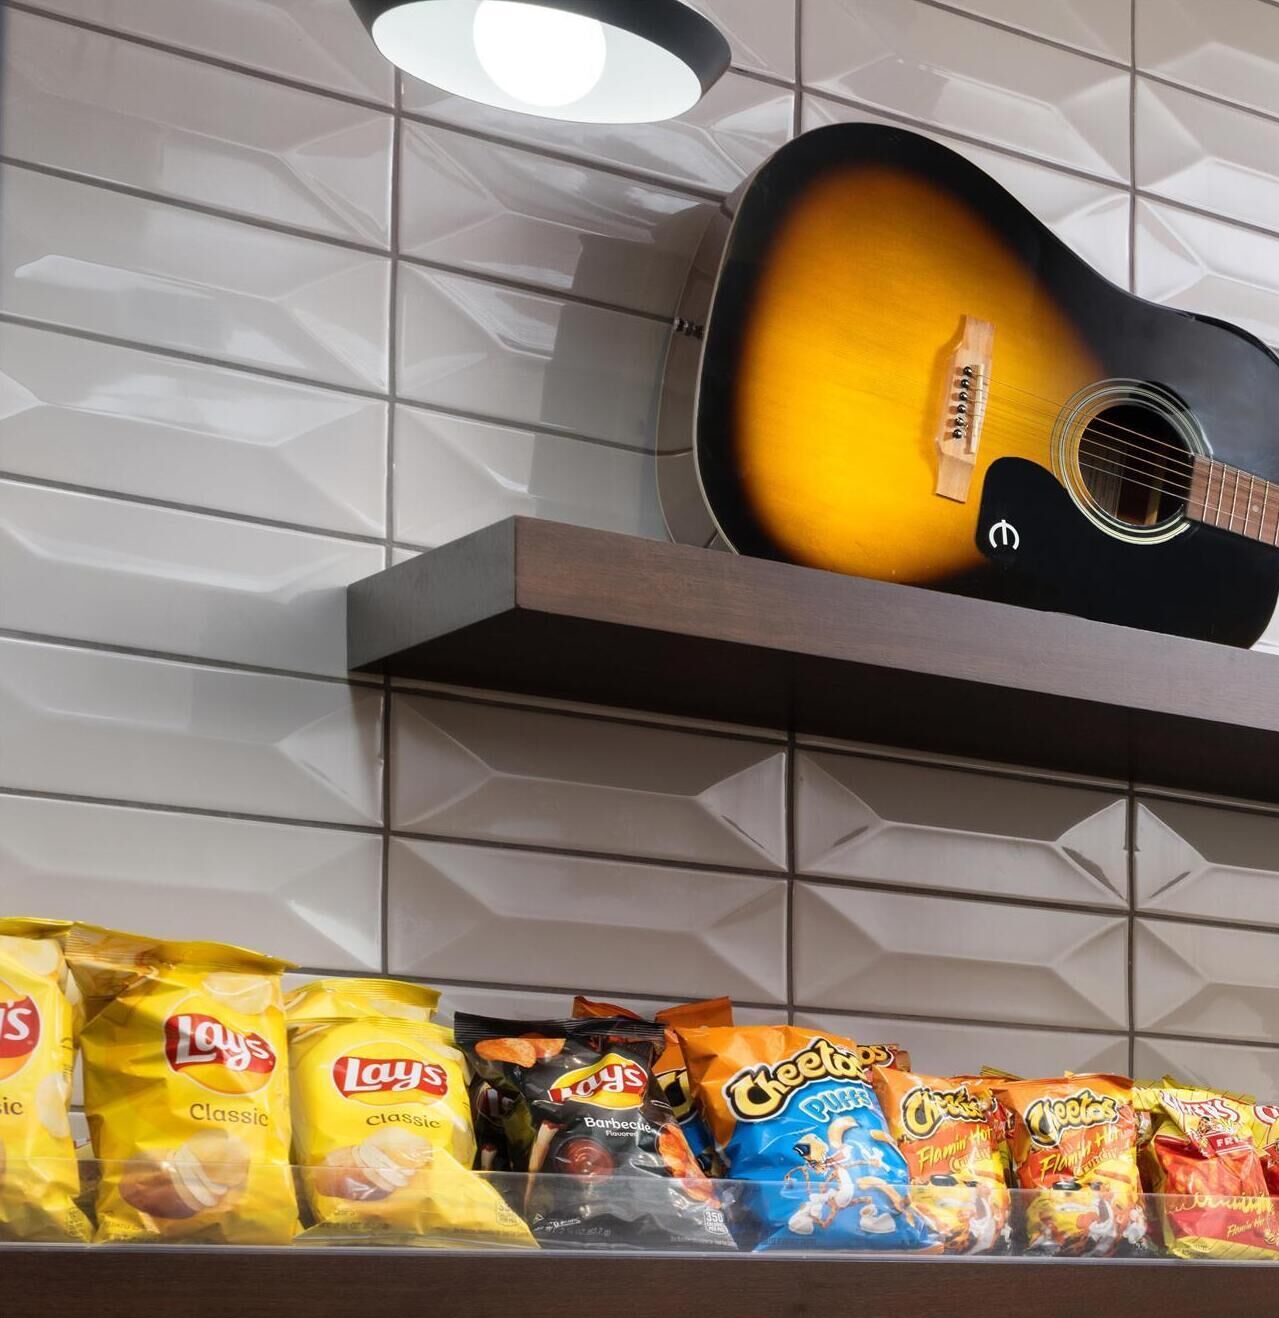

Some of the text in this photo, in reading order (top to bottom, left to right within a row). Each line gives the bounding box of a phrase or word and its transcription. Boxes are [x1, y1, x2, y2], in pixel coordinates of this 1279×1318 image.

[344, 1056, 445, 1094] Lay's
[190, 1103, 268, 1127] Classic
[801, 1086, 875, 1121] PUFFS
[366, 1112, 441, 1129] Classic
[584, 1116, 651, 1134] Barbecue
[1025, 1089, 1117, 1146] Cheetos
[705, 1211, 724, 1222] 350
